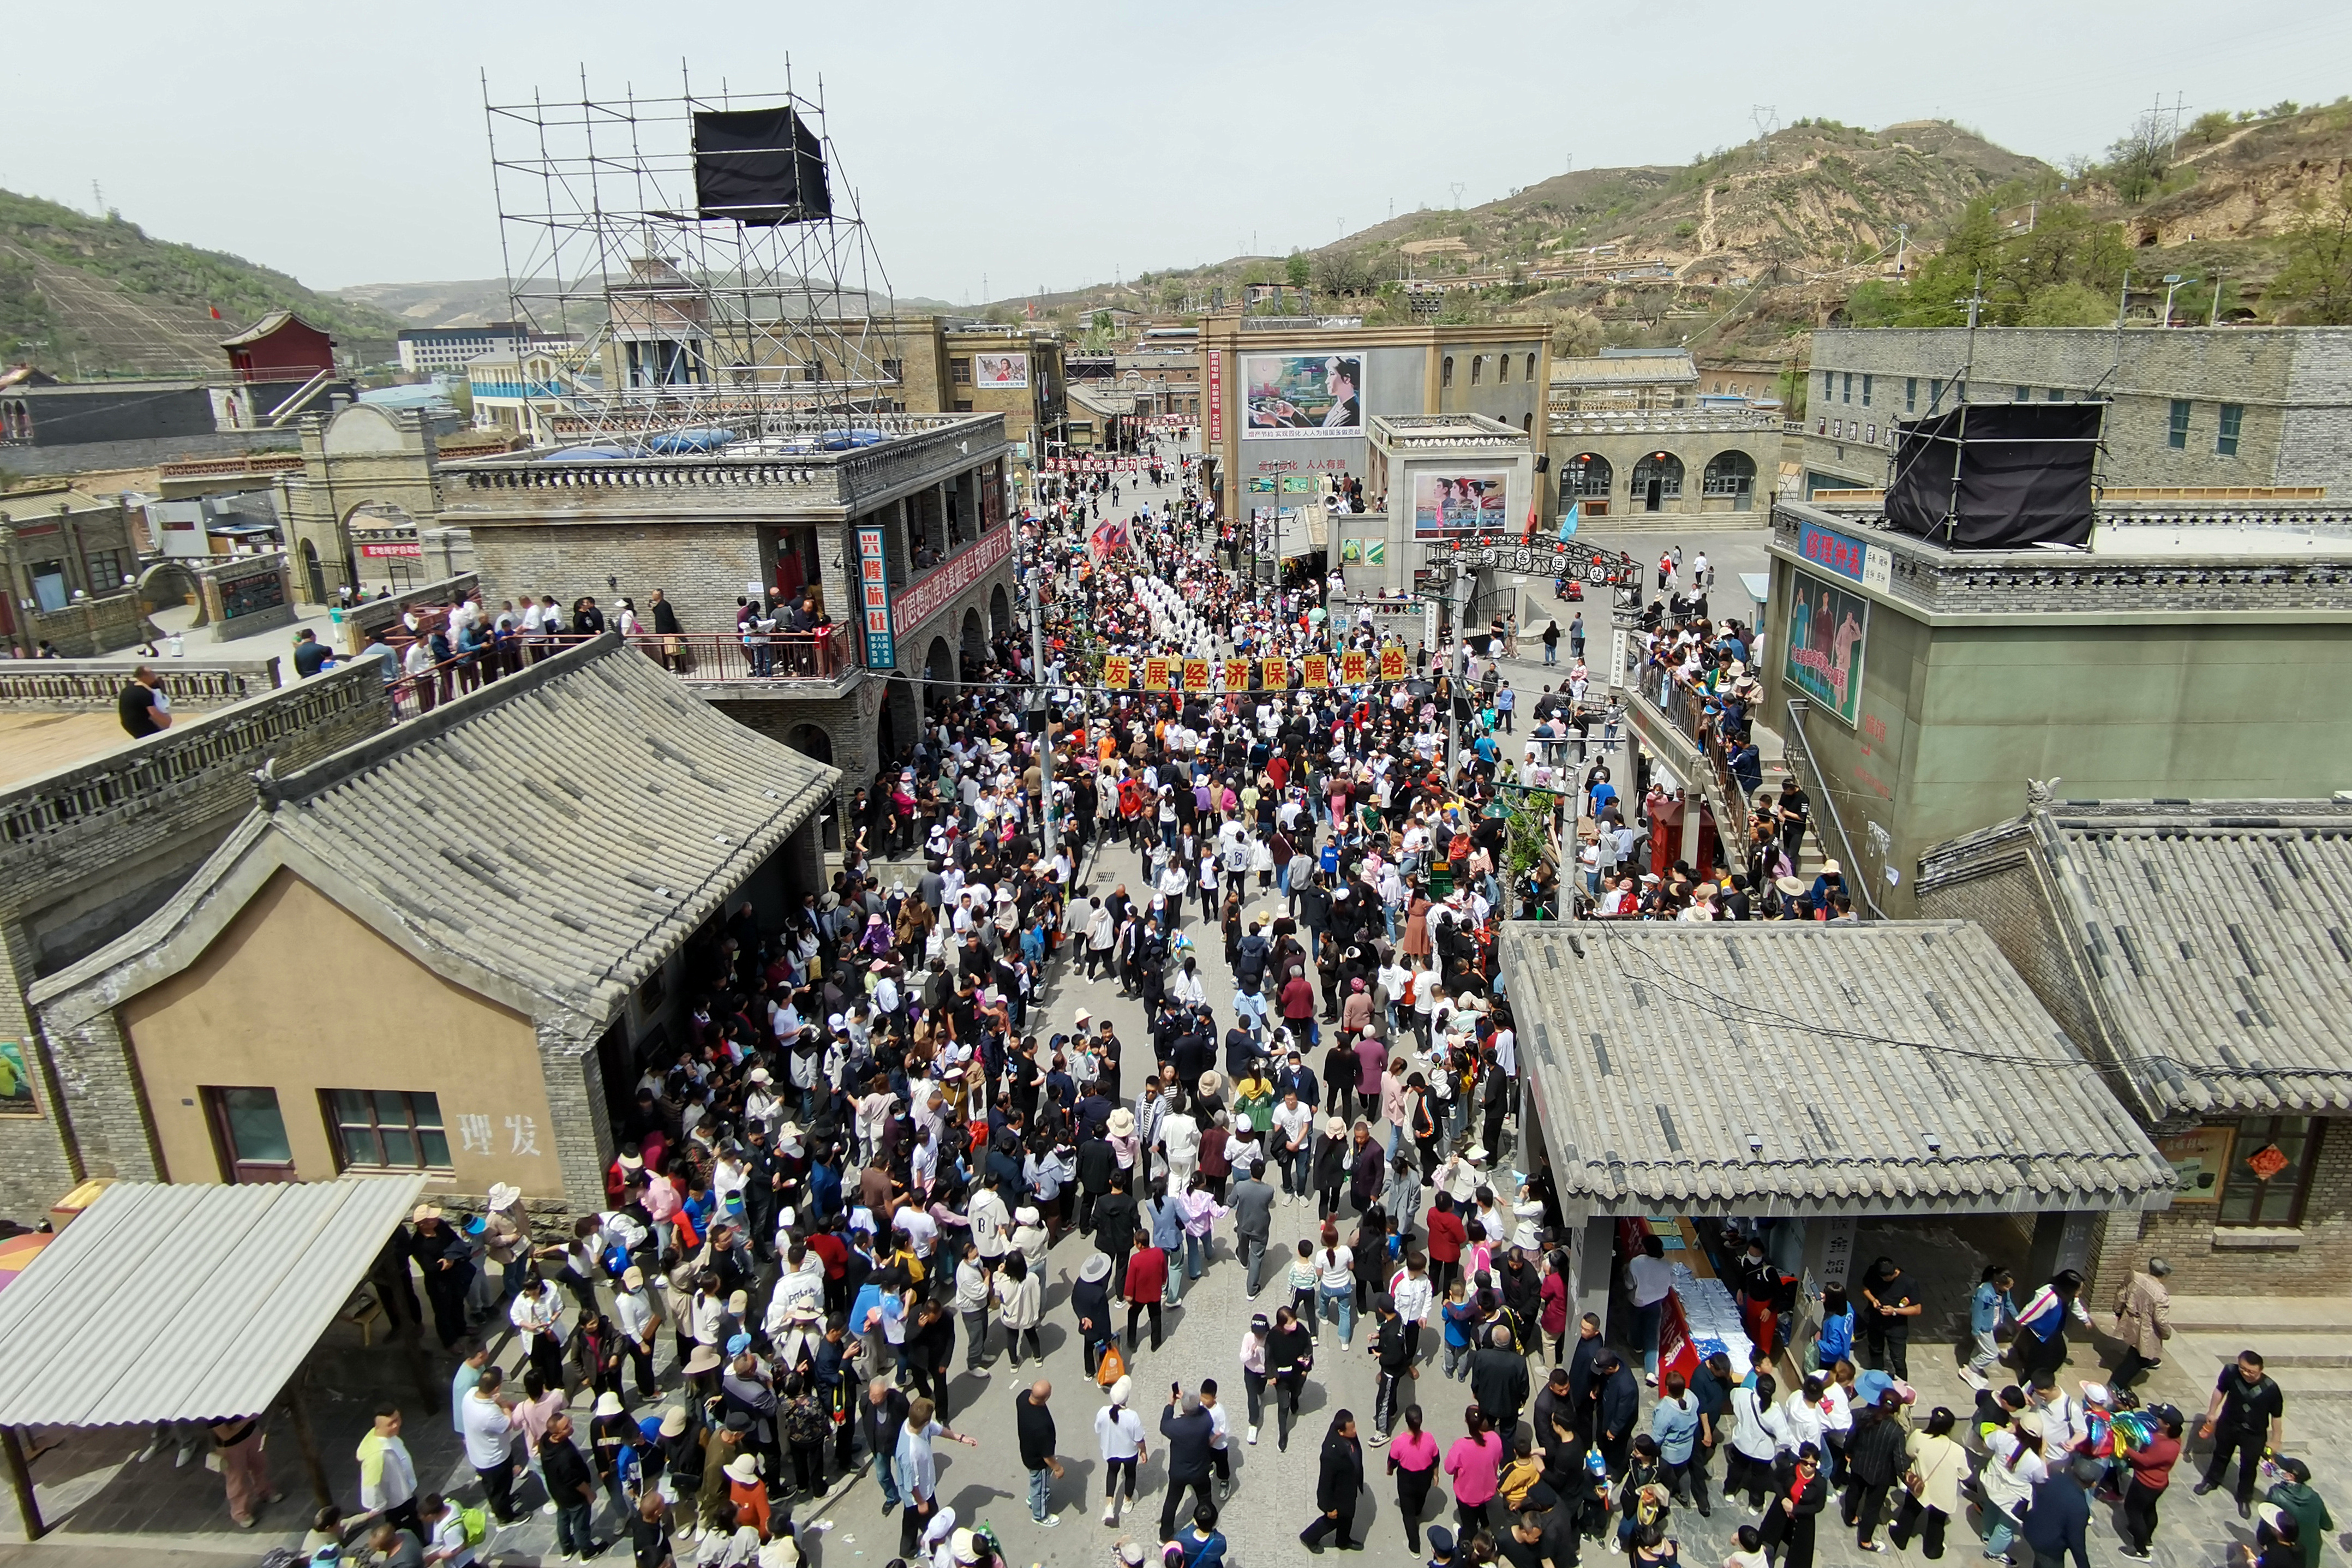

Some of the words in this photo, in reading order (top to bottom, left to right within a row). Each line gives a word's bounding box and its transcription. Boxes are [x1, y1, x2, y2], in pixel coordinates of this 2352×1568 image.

[1122, 415, 1201, 424] 开展五讲四美三热爱活
[1047, 457, 1162, 471] 为实现四化而努力奋斗
[1307, 459, 1345, 470] 人人有责
[1806, 529, 1860, 575] 修理钟表
[861, 535, 887, 631] 兴隆旅社
[1108, 651, 1403, 687] 发展经济保障供给
[457, 1114, 541, 1157] 理发
